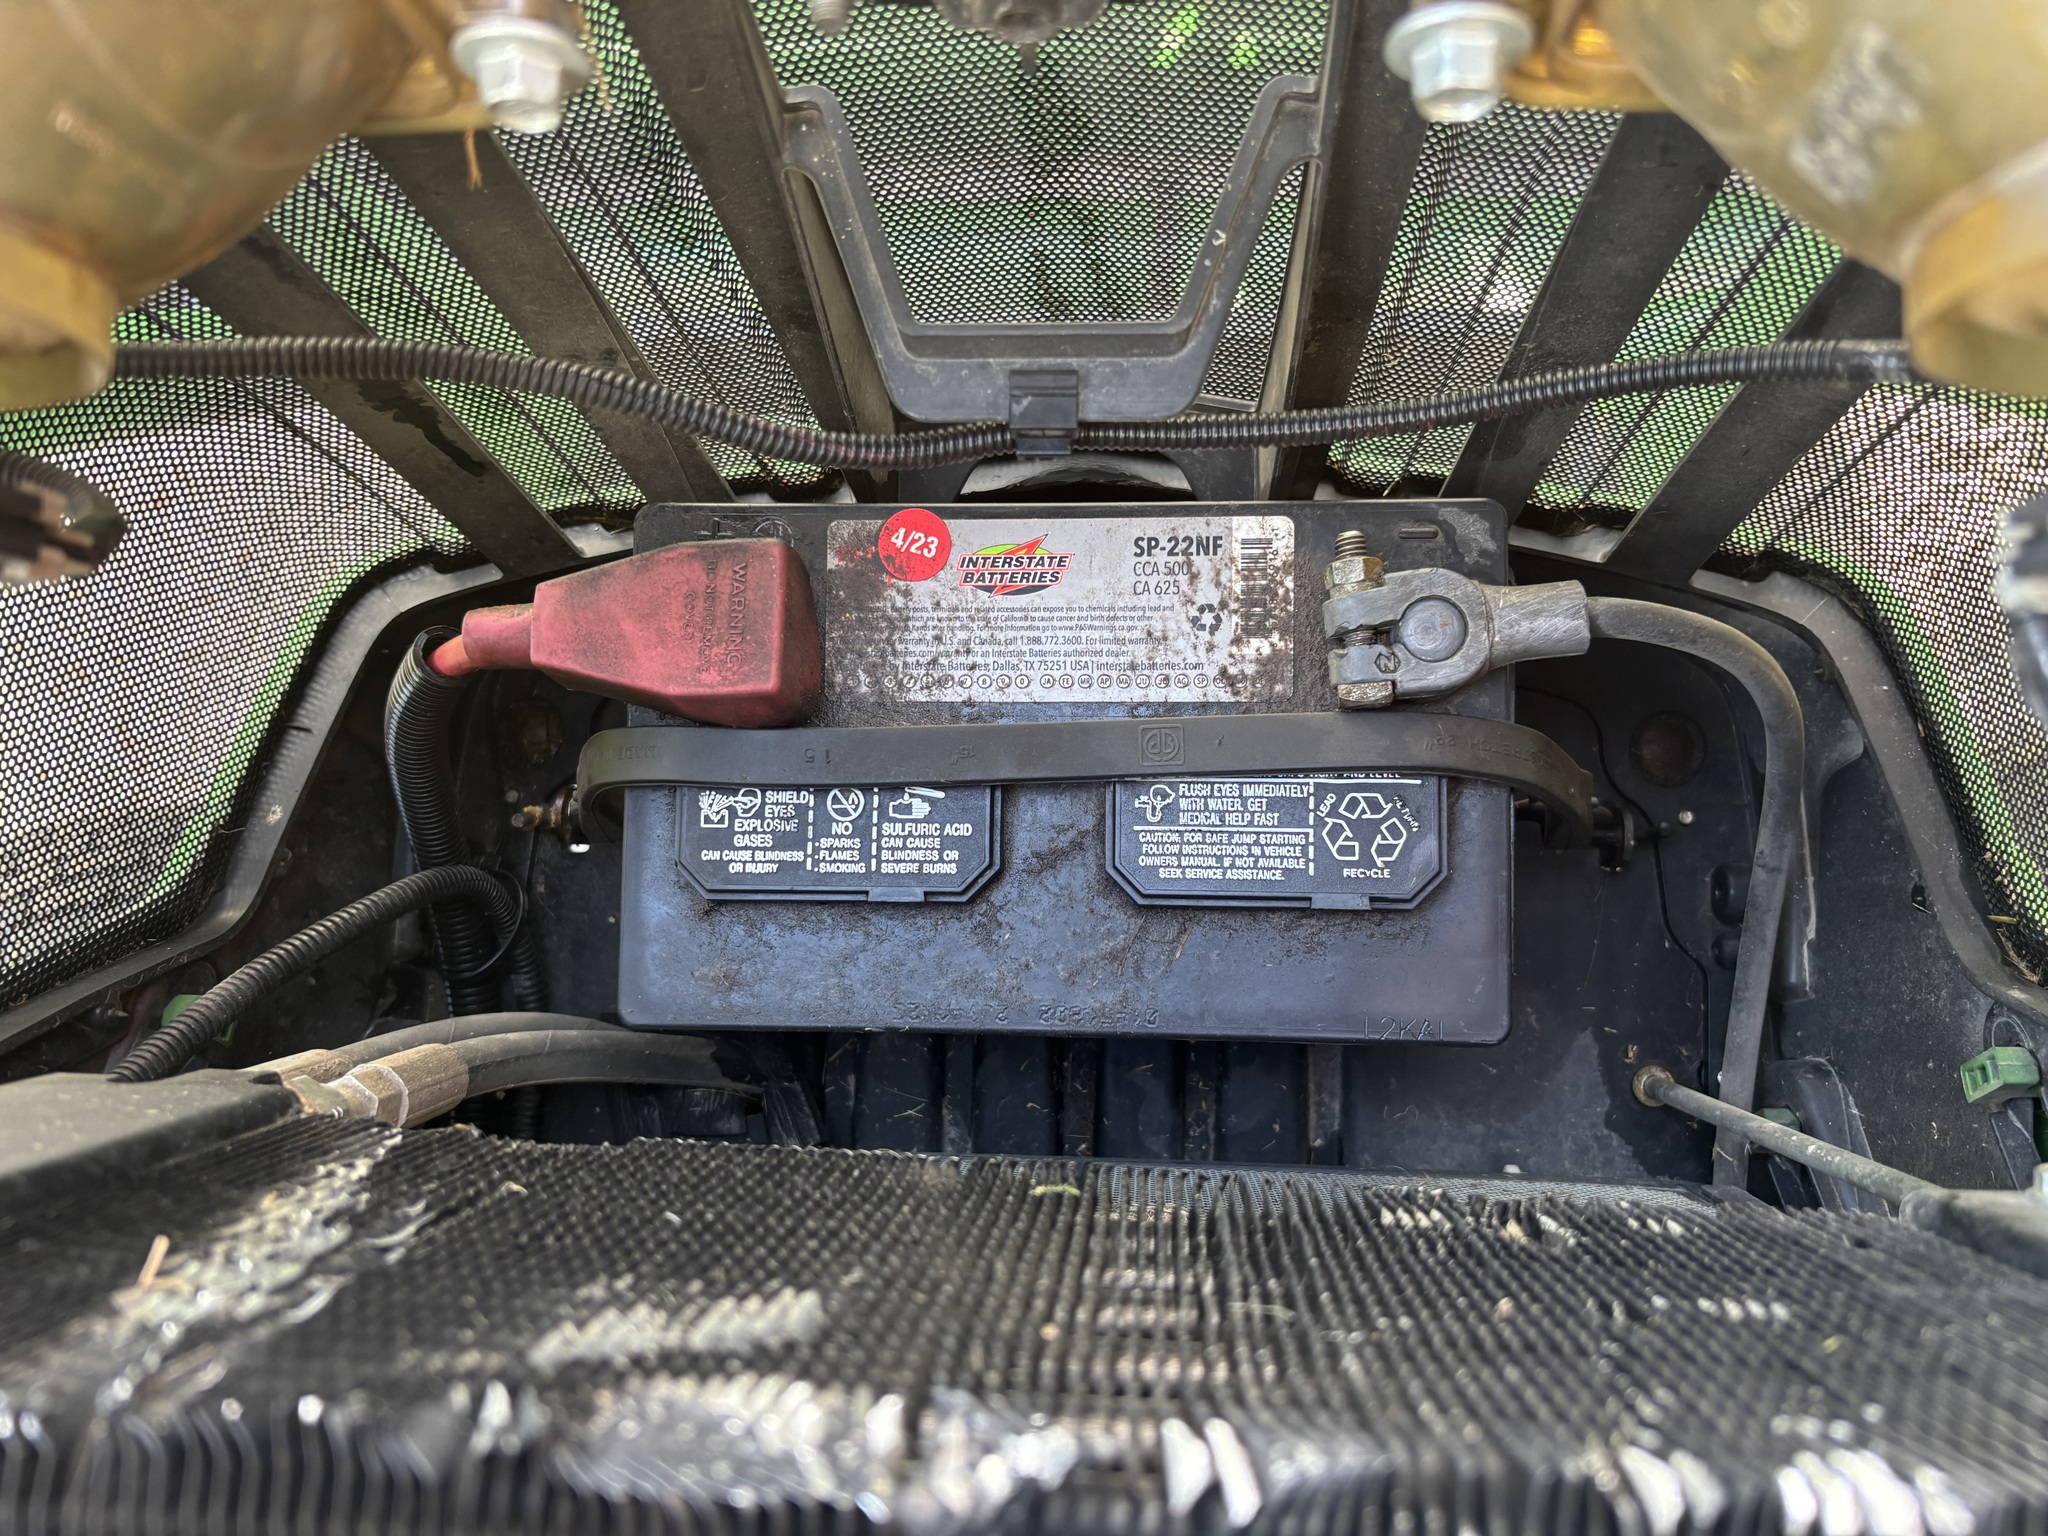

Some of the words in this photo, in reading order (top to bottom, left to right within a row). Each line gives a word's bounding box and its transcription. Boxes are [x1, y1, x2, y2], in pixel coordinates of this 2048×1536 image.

[890, 527, 939, 559] 4/23
[1133, 535, 1223, 557] SP-22NF
[958, 555, 1069, 569] INTERSTATE
[1133, 561, 1160, 577] CCA
[1163, 561, 1190, 577] 500
[962, 571, 1061, 584] BATTERIES
[1133, 580, 1150, 596] CA
[1154, 580, 1180, 596] 625
[726, 562, 748, 670] WARNING
[912, 606, 930, 615] posts,
[997, 605, 1029, 613] accessories
[1042, 605, 1064, 615] expose
[1065, 606, 1077, 615] you
[1078, 605, 1084, 613] to
[1085, 605, 1116, 613] chemicals
[1117, 604, 1146, 614] including
[1147, 604, 1161, 612] lead
[1162, 604, 1174, 612] and
[993, 614, 1000, 623] of
[1001, 614, 1028, 623] California
[1030, 615, 1036, 623] to
[1037, 615, 1055, 623] cause
[1056, 615, 1076, 623] cancer
[1077, 614, 1088, 622] and
[1090, 614, 1104, 622] birth
[1106, 614, 1128, 622] defects
[1137, 614, 1153, 622] other
[977, 623, 987, 632] For
[987, 624, 1003, 632] more
[1005, 623, 1041, 632] information
[1042, 625, 1050, 633] go
[1051, 624, 1057, 632] to
[942, 635, 956, 646] U.S.
[957, 635, 971, 646] and
[973, 635, 1004, 647] Canada,
[1006, 635, 1018, 646] call
[1019, 635, 1084, 646] 1.888.772.3600.
[1085, 635, 1097, 646] For
[1098, 635, 1126, 646] limited
[971, 651, 980, 659] or
[992, 649, 1026, 658] Interstate
[1028, 649, 1061, 658] Batteries
[1063, 648, 1103, 658] authorized
[1105, 648, 1131, 658] dealer.
[902, 661, 945, 672] Interstate
[947, 661, 990, 674] Batteries,
[992, 661, 1022, 673] Dallas,
[1024, 661, 1035, 671] TX
[1037, 661, 1067, 671] 75251
[1070, 661, 1089, 671] USA
[1096, 660, 1204, 672] interstatebatteries.com
[765, 790, 809, 804] SHIELD
[1178, 784, 1211, 797] FLUSH
[1213, 784, 1240, 797] EYES
[1242, 784, 1309, 797] IMMEDIATELY
[765, 804, 796, 818] EYES
[1179, 798, 1205, 811] WITH
[1207, 798, 1244, 811] WATER.
[1247, 798, 1268, 811] GET
[1316, 793, 1337, 818] LEAD
[734, 819, 799, 832] EXPLOSIVE
[1179, 812, 1222, 825] MEDICAL
[1225, 812, 1251, 826] HELP
[1253, 812, 1280, 826] FAST
[831, 822, 853, 835] NO
[881, 822, 940, 836] SULFURIC
[943, 823, 973, 837] ACID
[733, 834, 773, 847] GASES
[819, 838, 861, 849] SPARKS
[881, 838, 903, 848] CAN
[906, 838, 941, 849] CAUSE
[1139, 832, 1182, 843] CAUTION:
[1183, 832, 1202, 843] FOR
[1205, 833, 1228, 844] SAFE
[1231, 833, 1257, 844] JUMP
[1259, 834, 1306, 845] STARTING
[701, 850, 720, 861] CAN
[722, 850, 753, 861] CAUSE
[754, 850, 804, 862] BLINDNESS
[819, 850, 860, 861] FLAMES
[881, 850, 939, 861] BLINDNESS
[943, 850, 959, 861] OR
[1142, 844, 1180, 854] FOLLOW
[1182, 845, 1249, 856] INSTRUCTIONS
[1251, 846, 1261, 856] IN
[1263, 846, 1302, 857] VEHICLE
[728, 863, 744, 873] OR
[745, 863, 779, 874] INJURY
[819, 863, 866, 873] SMOKING
[881, 863, 920, 873] SEVERE
[923, 863, 958, 874] BURNS
[1138, 856, 1179, 866] OWNERS
[1180, 856, 1221, 867] MANUAL.
[1223, 857, 1233, 868] IF
[1235, 857, 1255, 868] NOT
[1257, 858, 1306, 869] AVAILABLE
[1158, 868, 1183, 878] SEEK
[1185, 868, 1223, 879] SERVICE
[1225, 869, 1285, 880] ASSISTANCE.
[1343, 868, 1391, 878] RECYCLE
